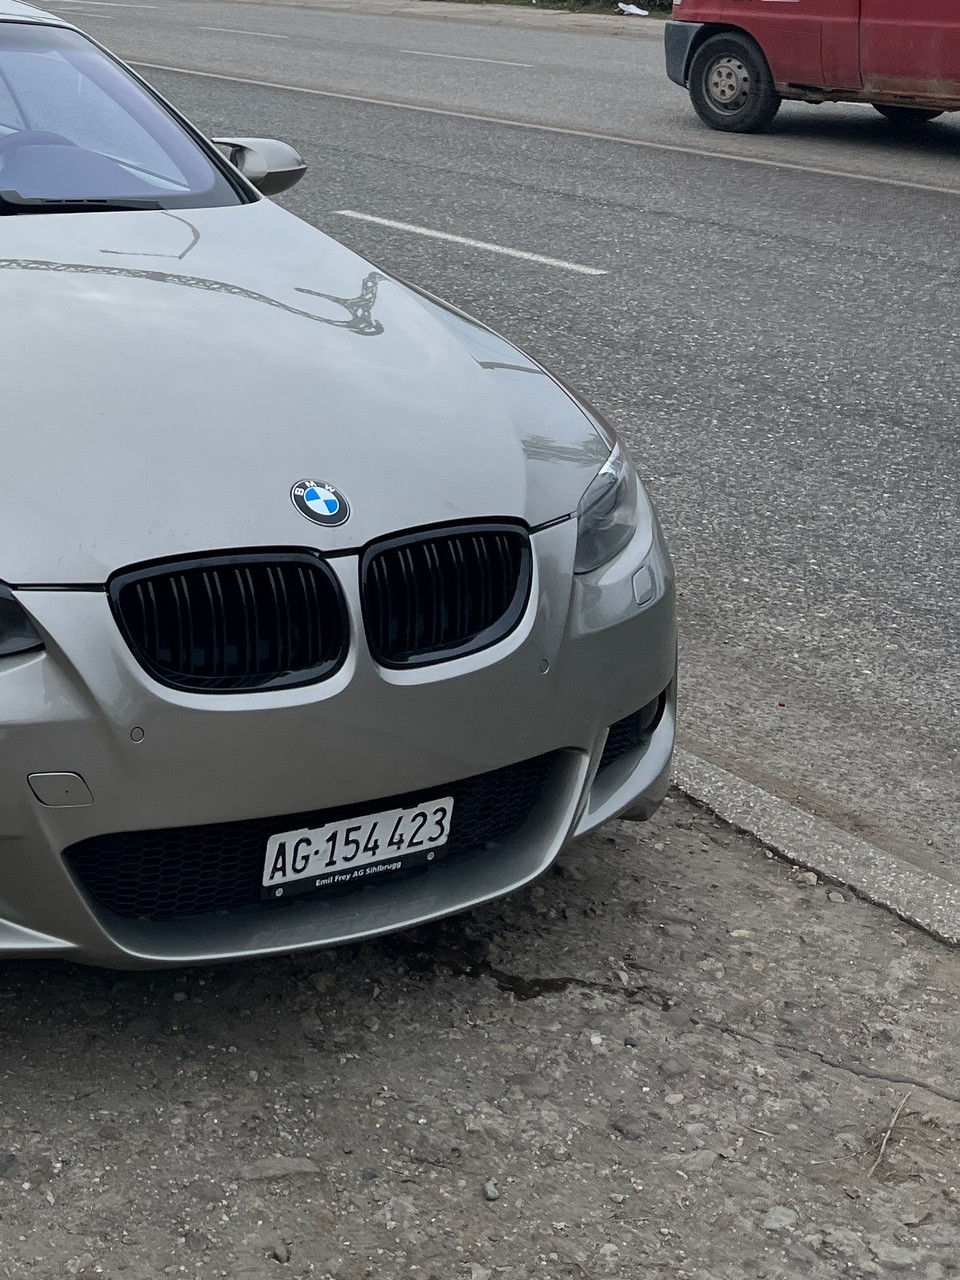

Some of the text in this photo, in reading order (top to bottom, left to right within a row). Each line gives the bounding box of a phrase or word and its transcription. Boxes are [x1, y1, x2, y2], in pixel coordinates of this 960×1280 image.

[294, 481, 336, 496] BMW
[316, 860, 402, 886] Emil Frey AG Sihlbrugg
